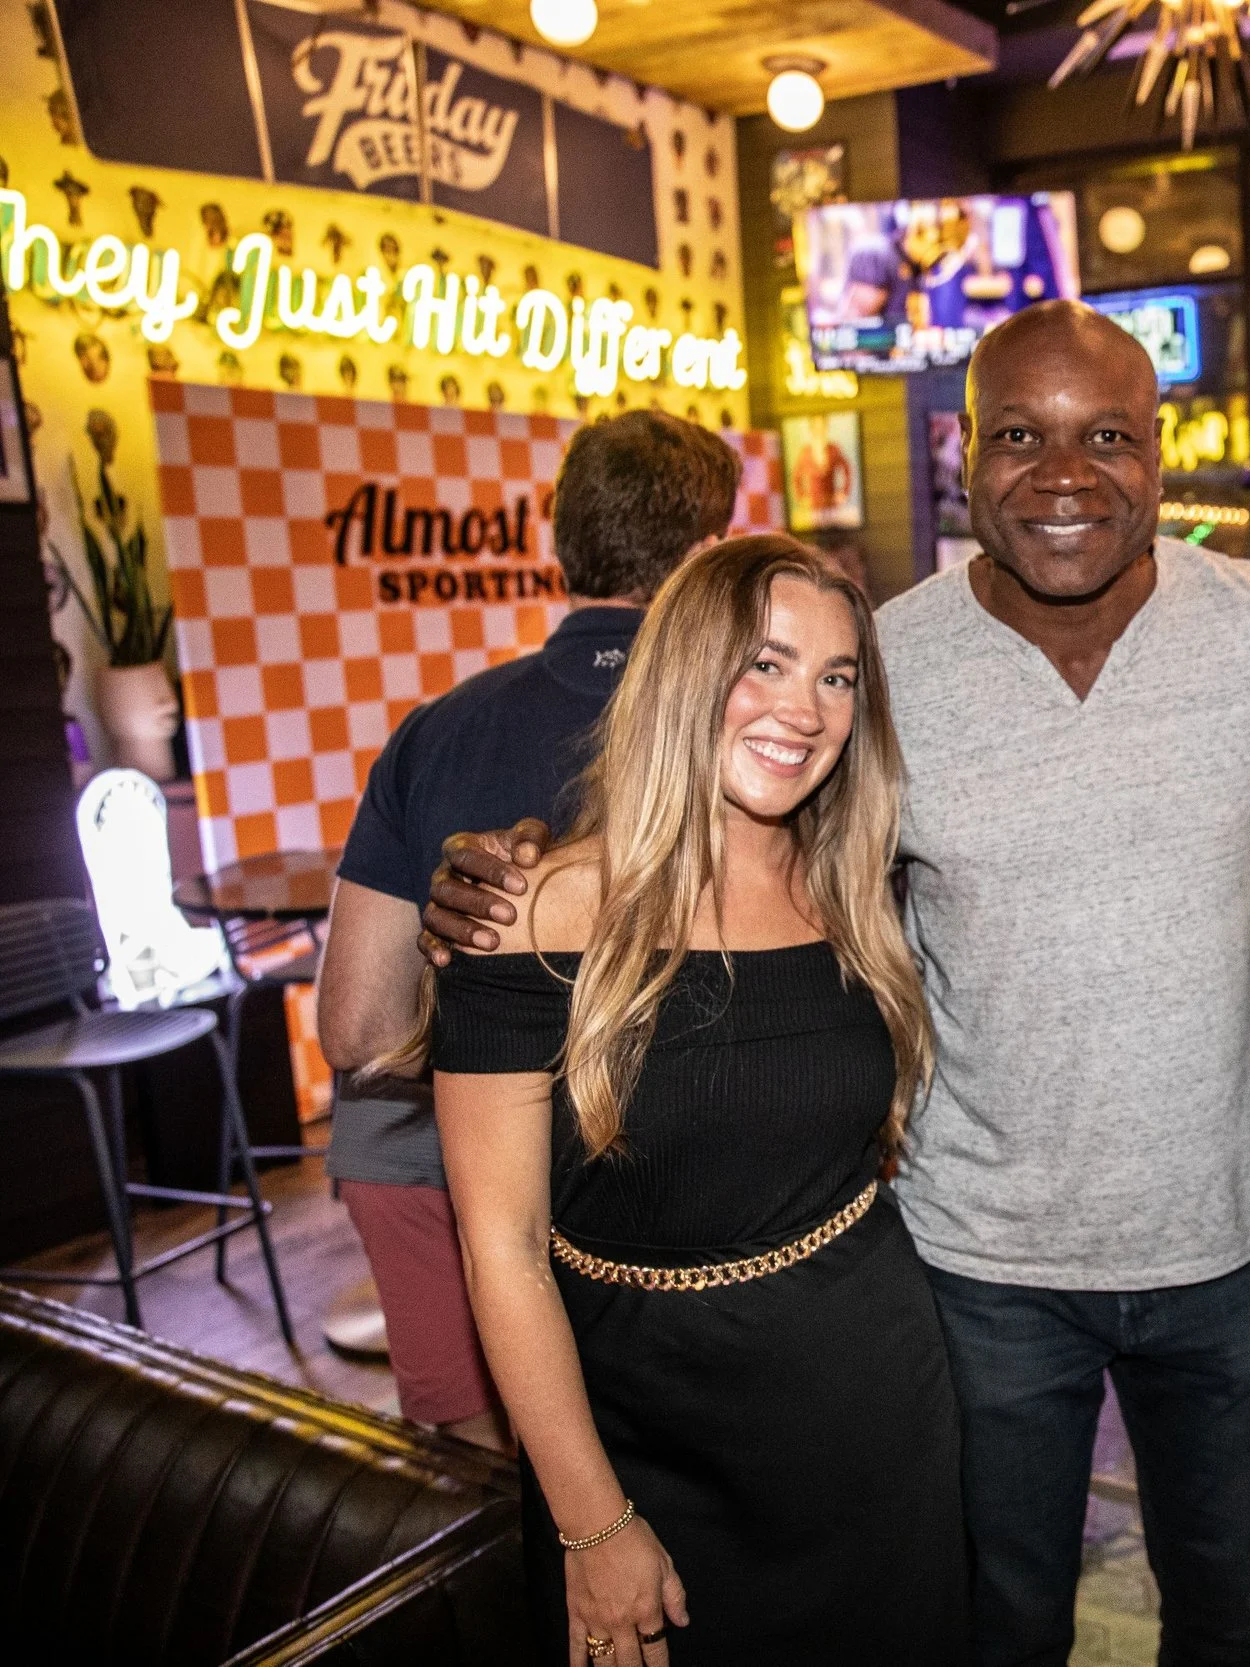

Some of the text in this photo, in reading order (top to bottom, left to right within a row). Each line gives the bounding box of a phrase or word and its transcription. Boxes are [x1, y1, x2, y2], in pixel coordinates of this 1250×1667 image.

[291, 31, 519, 168] Friday
[358, 131, 464, 184] BEERS
[0, 188, 198, 343] hey
[216, 232, 397, 350] Just
[402, 264, 511, 357] Hit
[516, 288, 747, 397] Different
[325, 483, 530, 567] Almost
